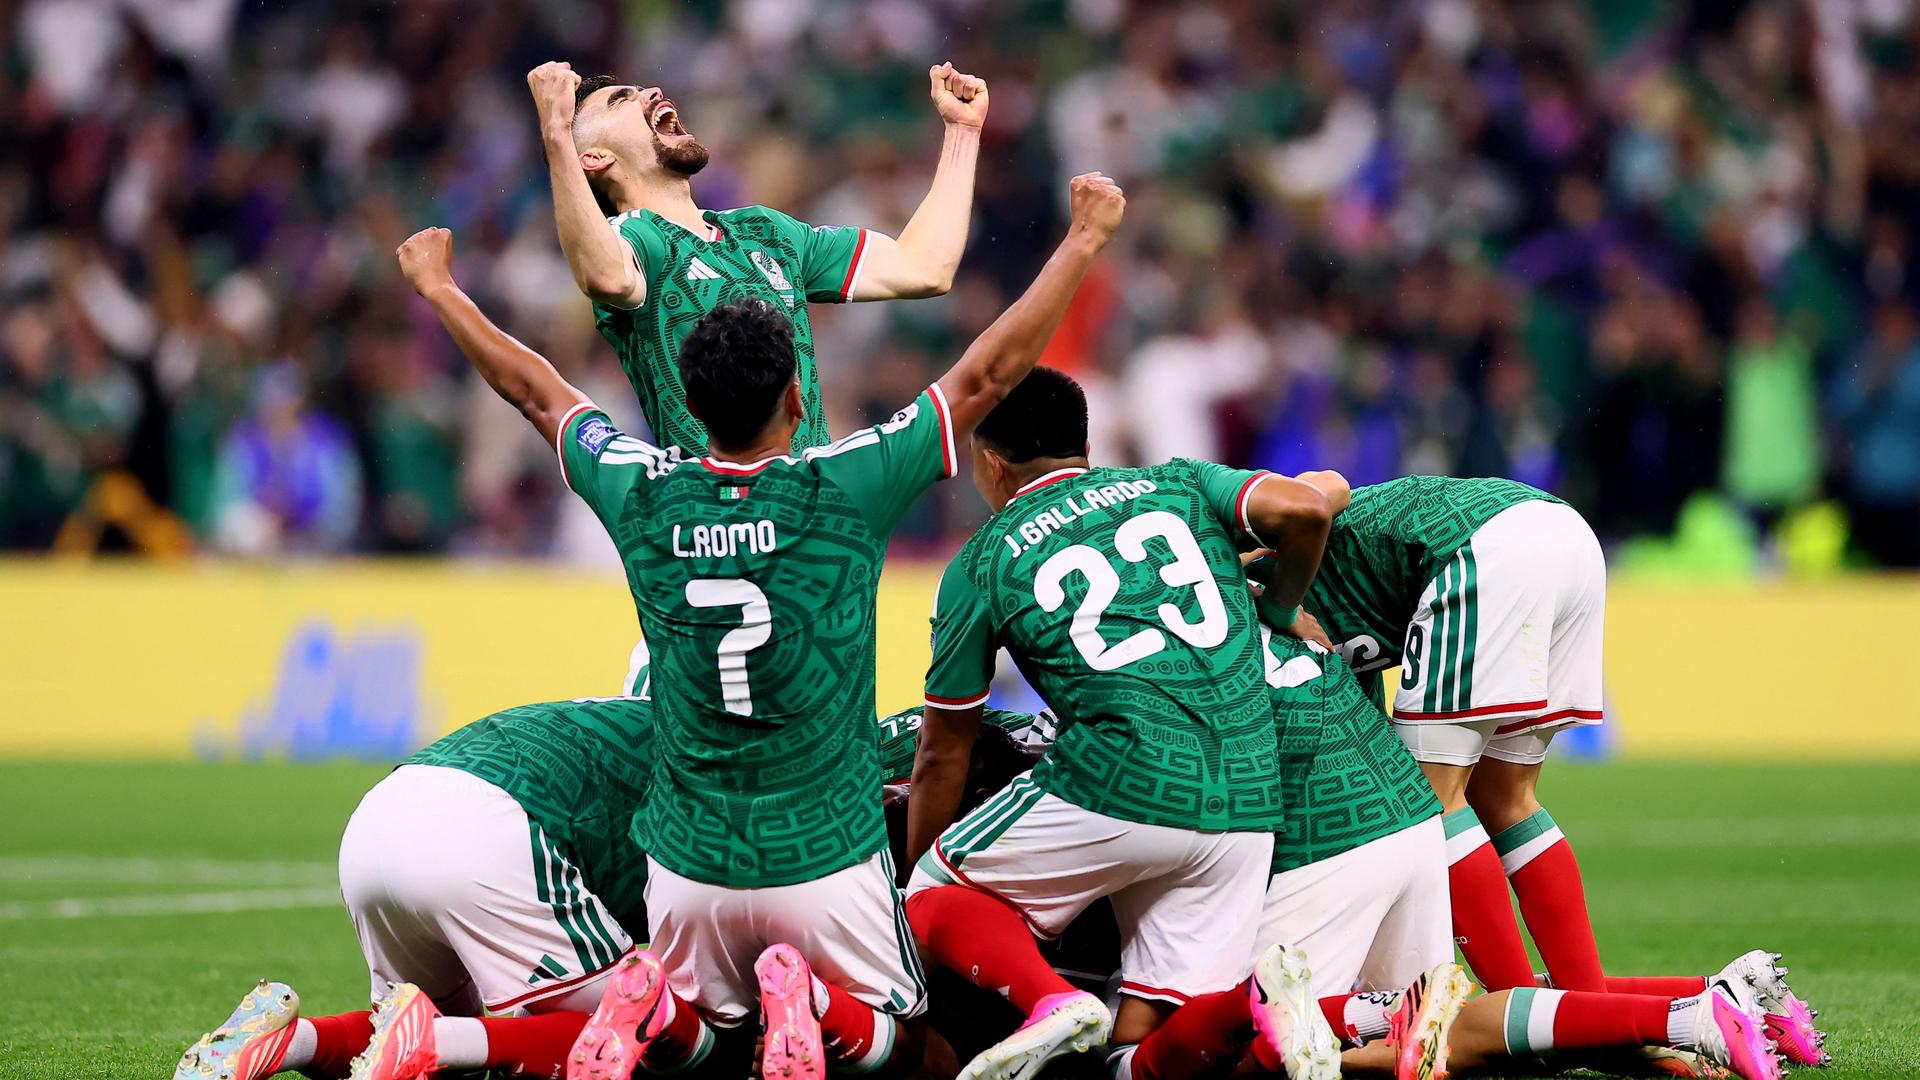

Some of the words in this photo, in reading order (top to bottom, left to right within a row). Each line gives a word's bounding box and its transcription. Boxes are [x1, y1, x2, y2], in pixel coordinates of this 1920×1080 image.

[672, 519, 777, 558] L.ROMO
[1003, 479, 1158, 559] J.GALLARDO
[1033, 510, 1229, 672] 23
[685, 577, 773, 718] 7
